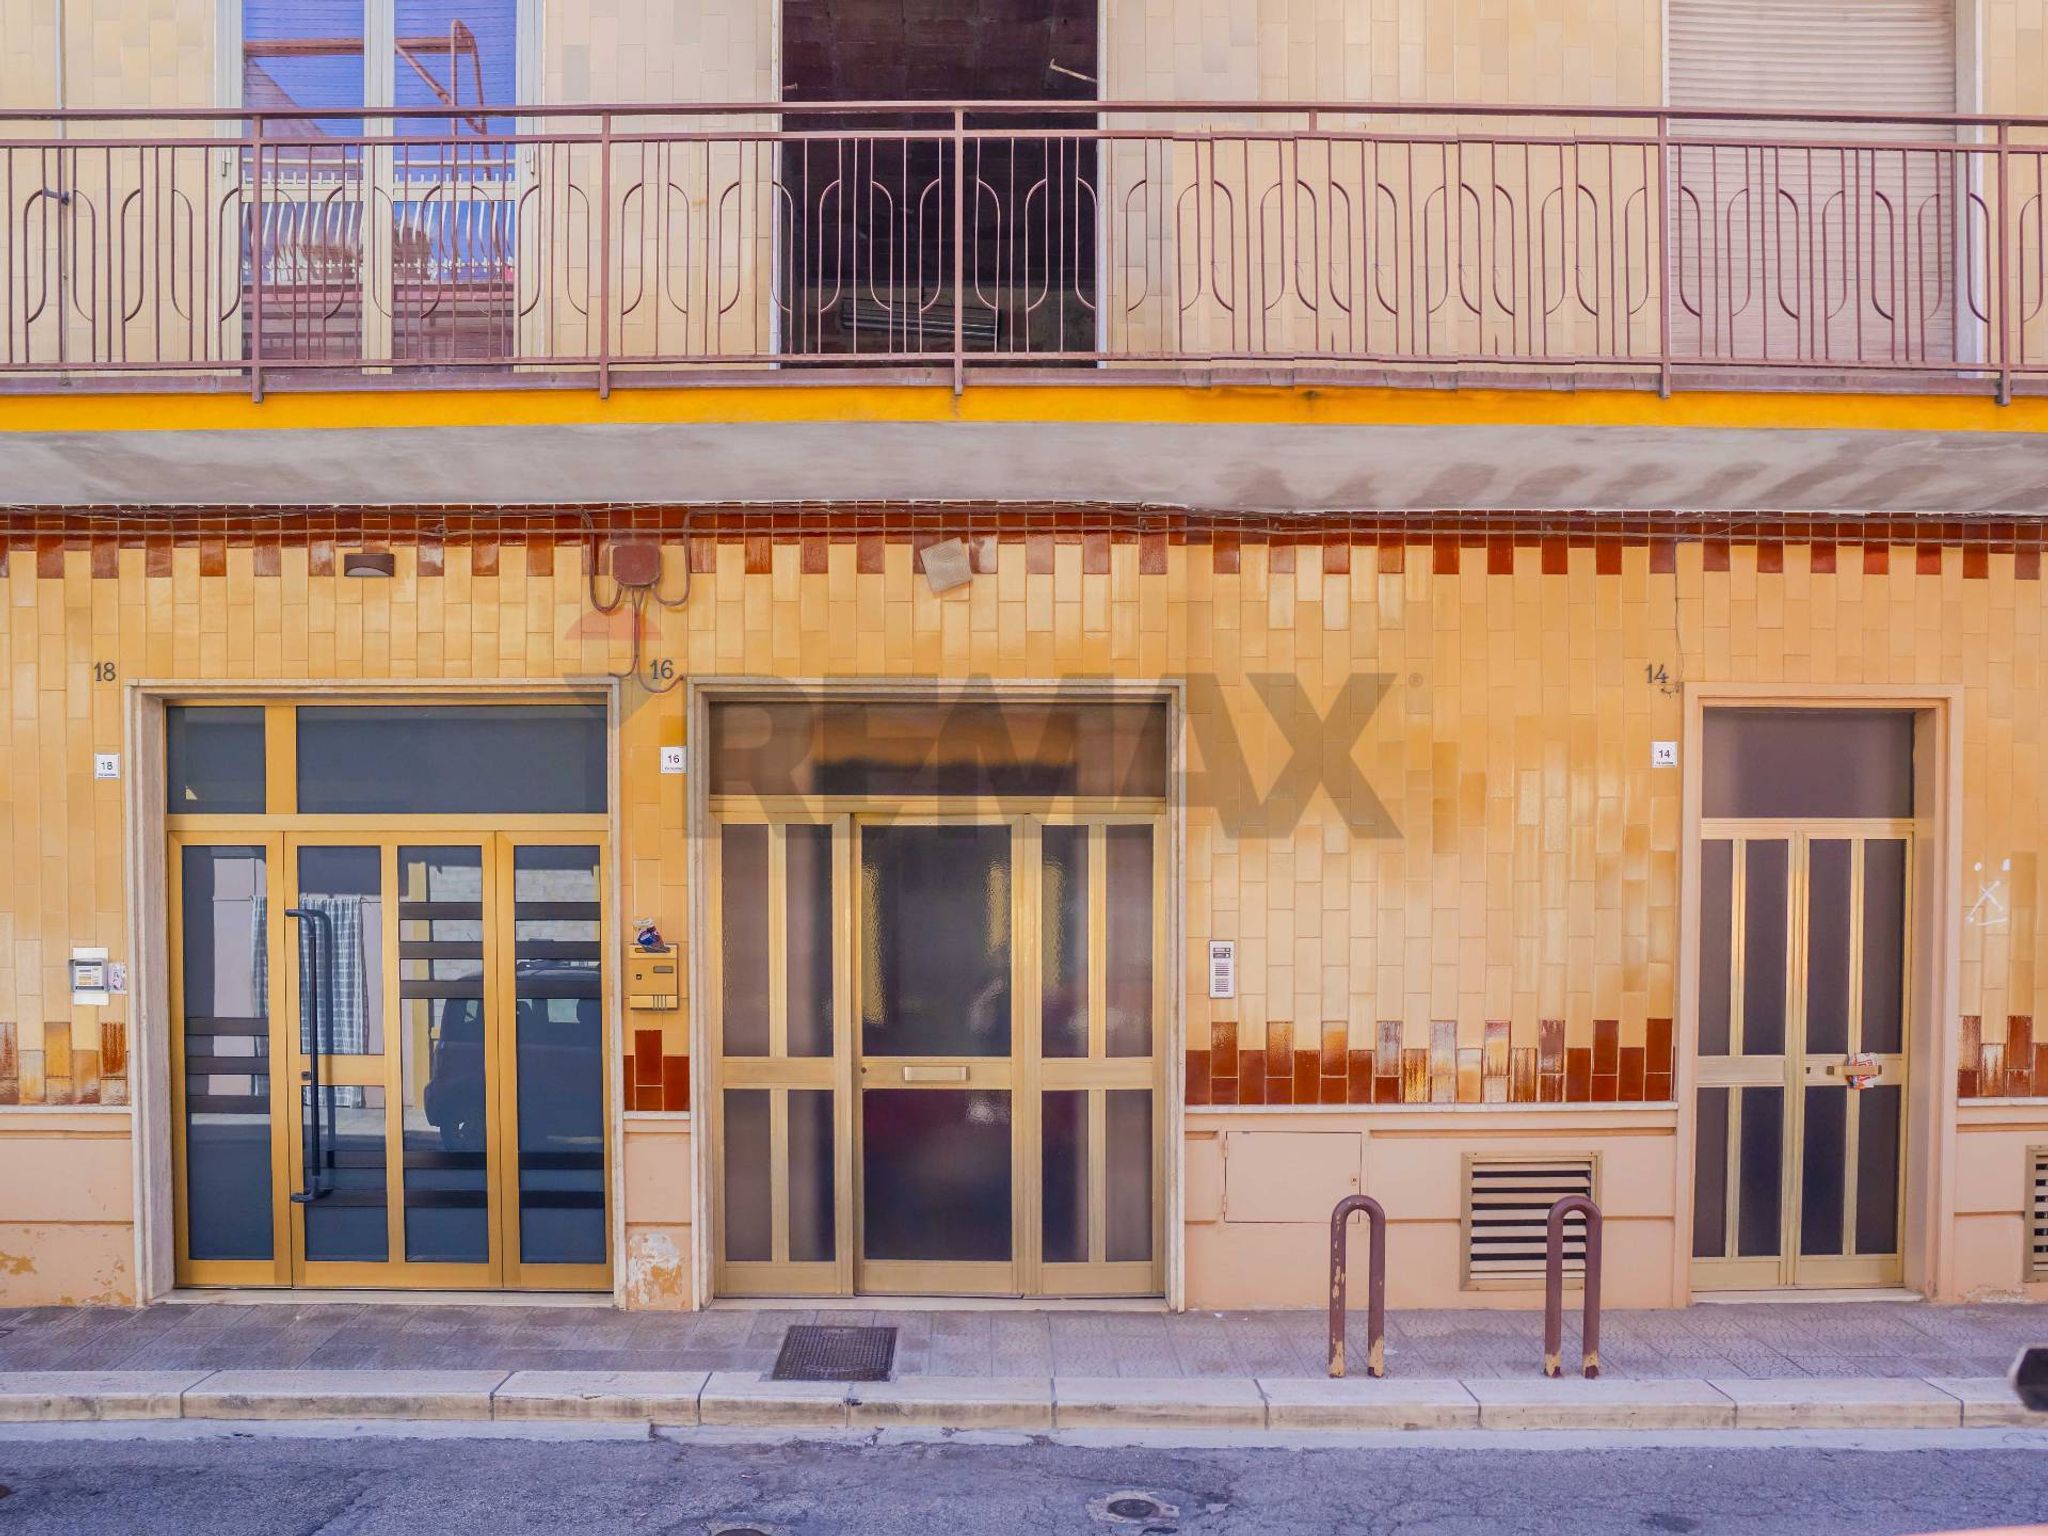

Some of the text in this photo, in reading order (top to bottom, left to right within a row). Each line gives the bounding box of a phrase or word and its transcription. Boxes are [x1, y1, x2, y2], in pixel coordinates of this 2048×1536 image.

[94, 661, 116, 681] 18
[649, 659, 673, 680] 16
[1645, 663, 1669, 684] 14
[668, 754, 680, 764] 16
[1658, 749, 1671, 759] 14
[100, 761, 113, 771] 18
